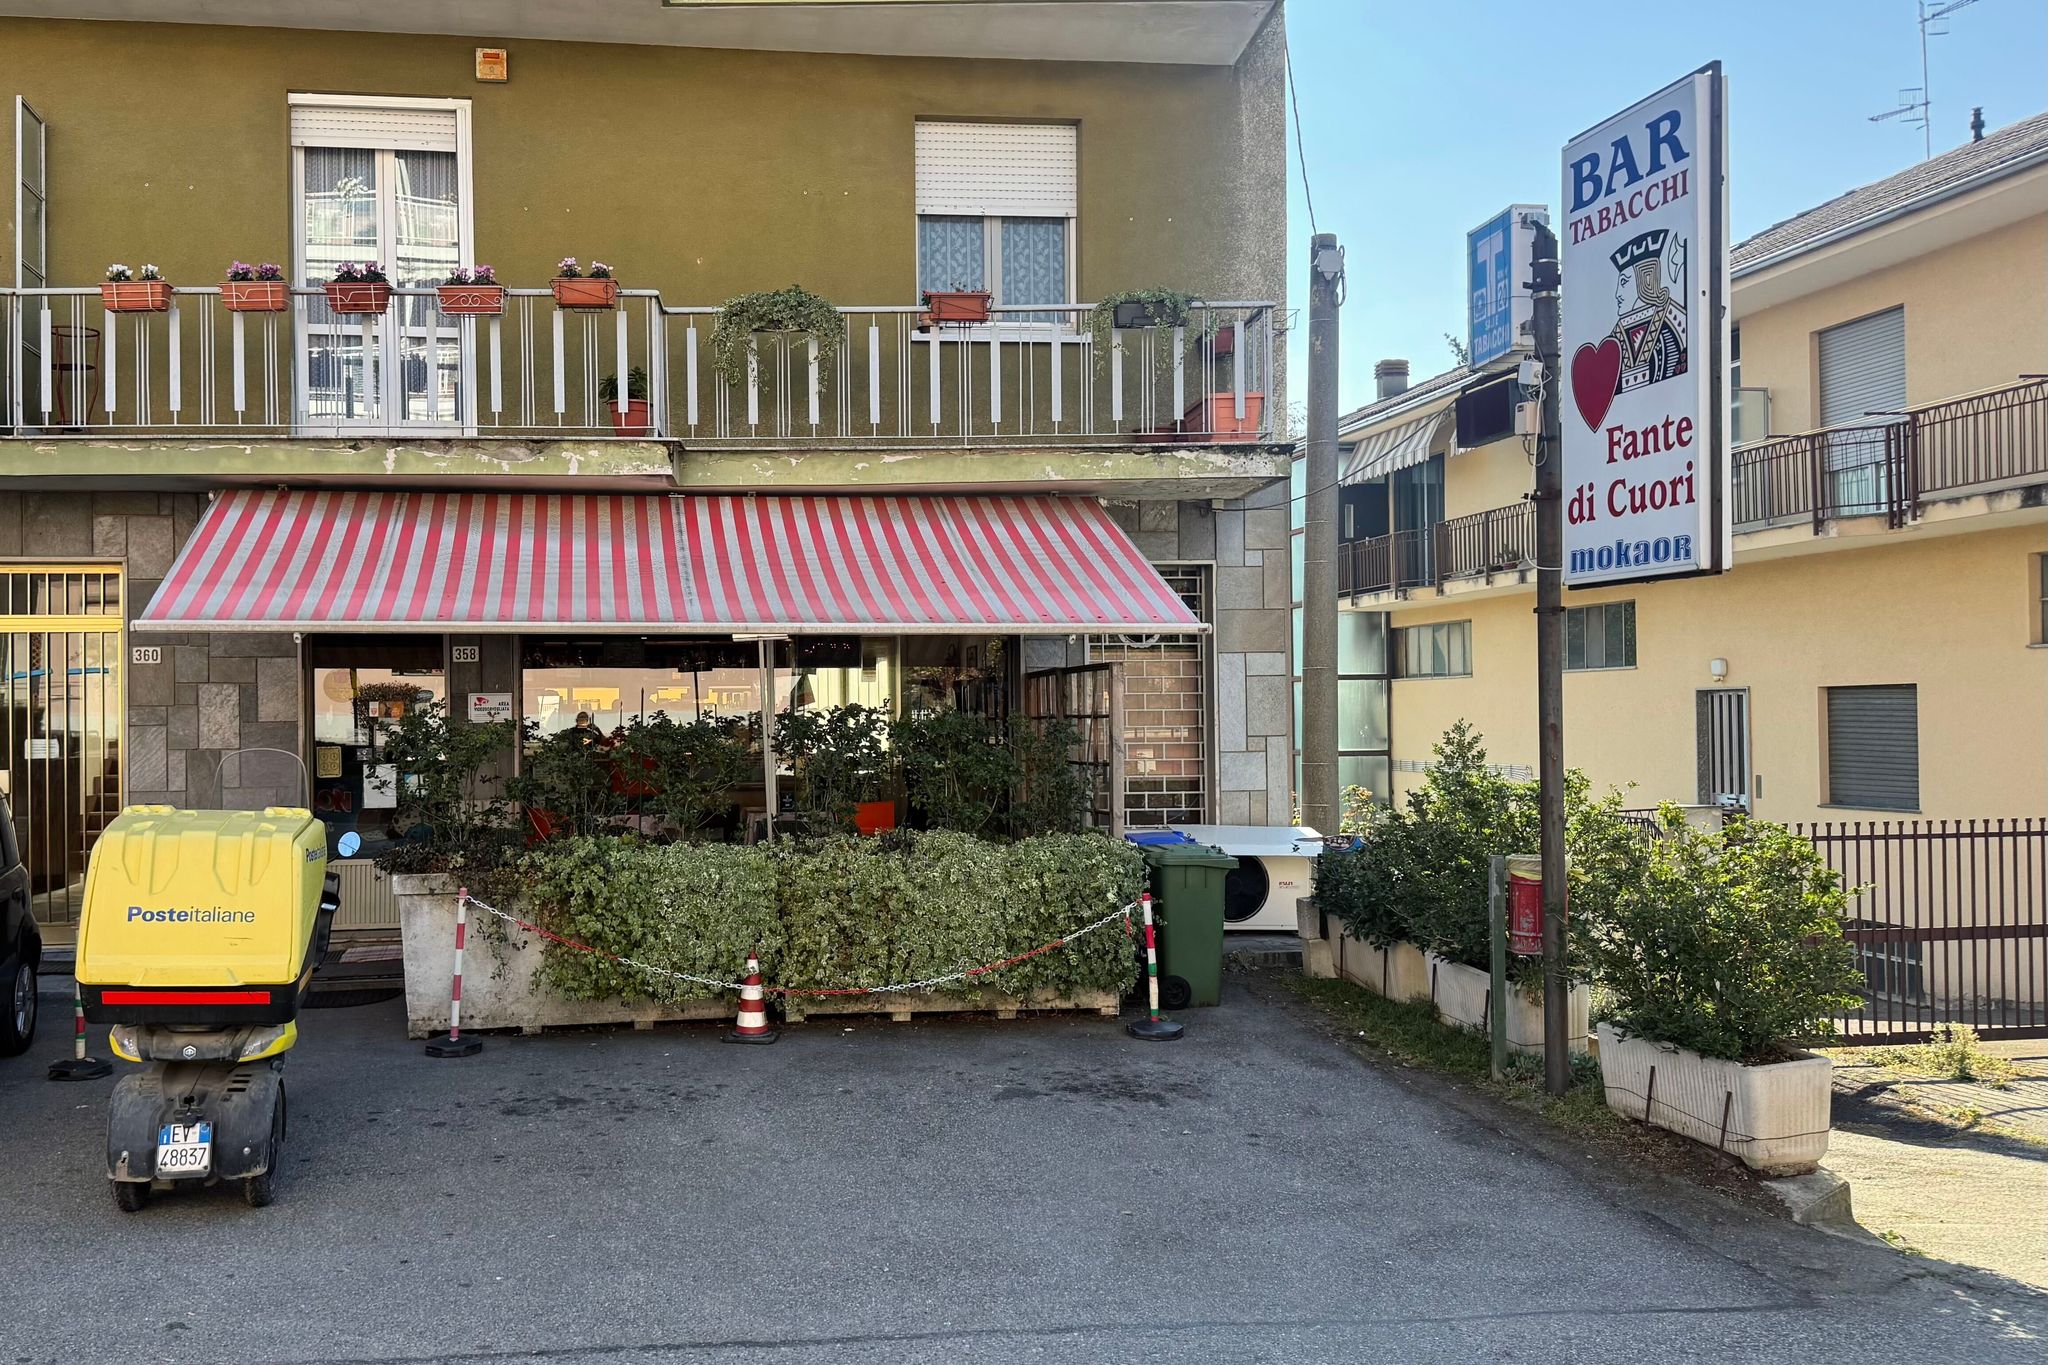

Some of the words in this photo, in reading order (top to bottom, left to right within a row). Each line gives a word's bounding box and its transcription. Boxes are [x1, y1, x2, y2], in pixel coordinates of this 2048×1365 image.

[1569, 109, 1690, 214] BAR
[1569, 168, 1690, 246] TABACCHI
[1476, 228, 1504, 317] T
[1605, 414, 1693, 465] Fante
[1567, 482, 1597, 525] di
[1607, 460, 1696, 518] Cuori
[134, 648, 159, 662] 360
[454, 647, 476, 661] 358
[127, 905, 256, 923] Posteitaliane
[172, 1125, 191, 1143] EV
[160, 1147, 207, 1167] 48837
